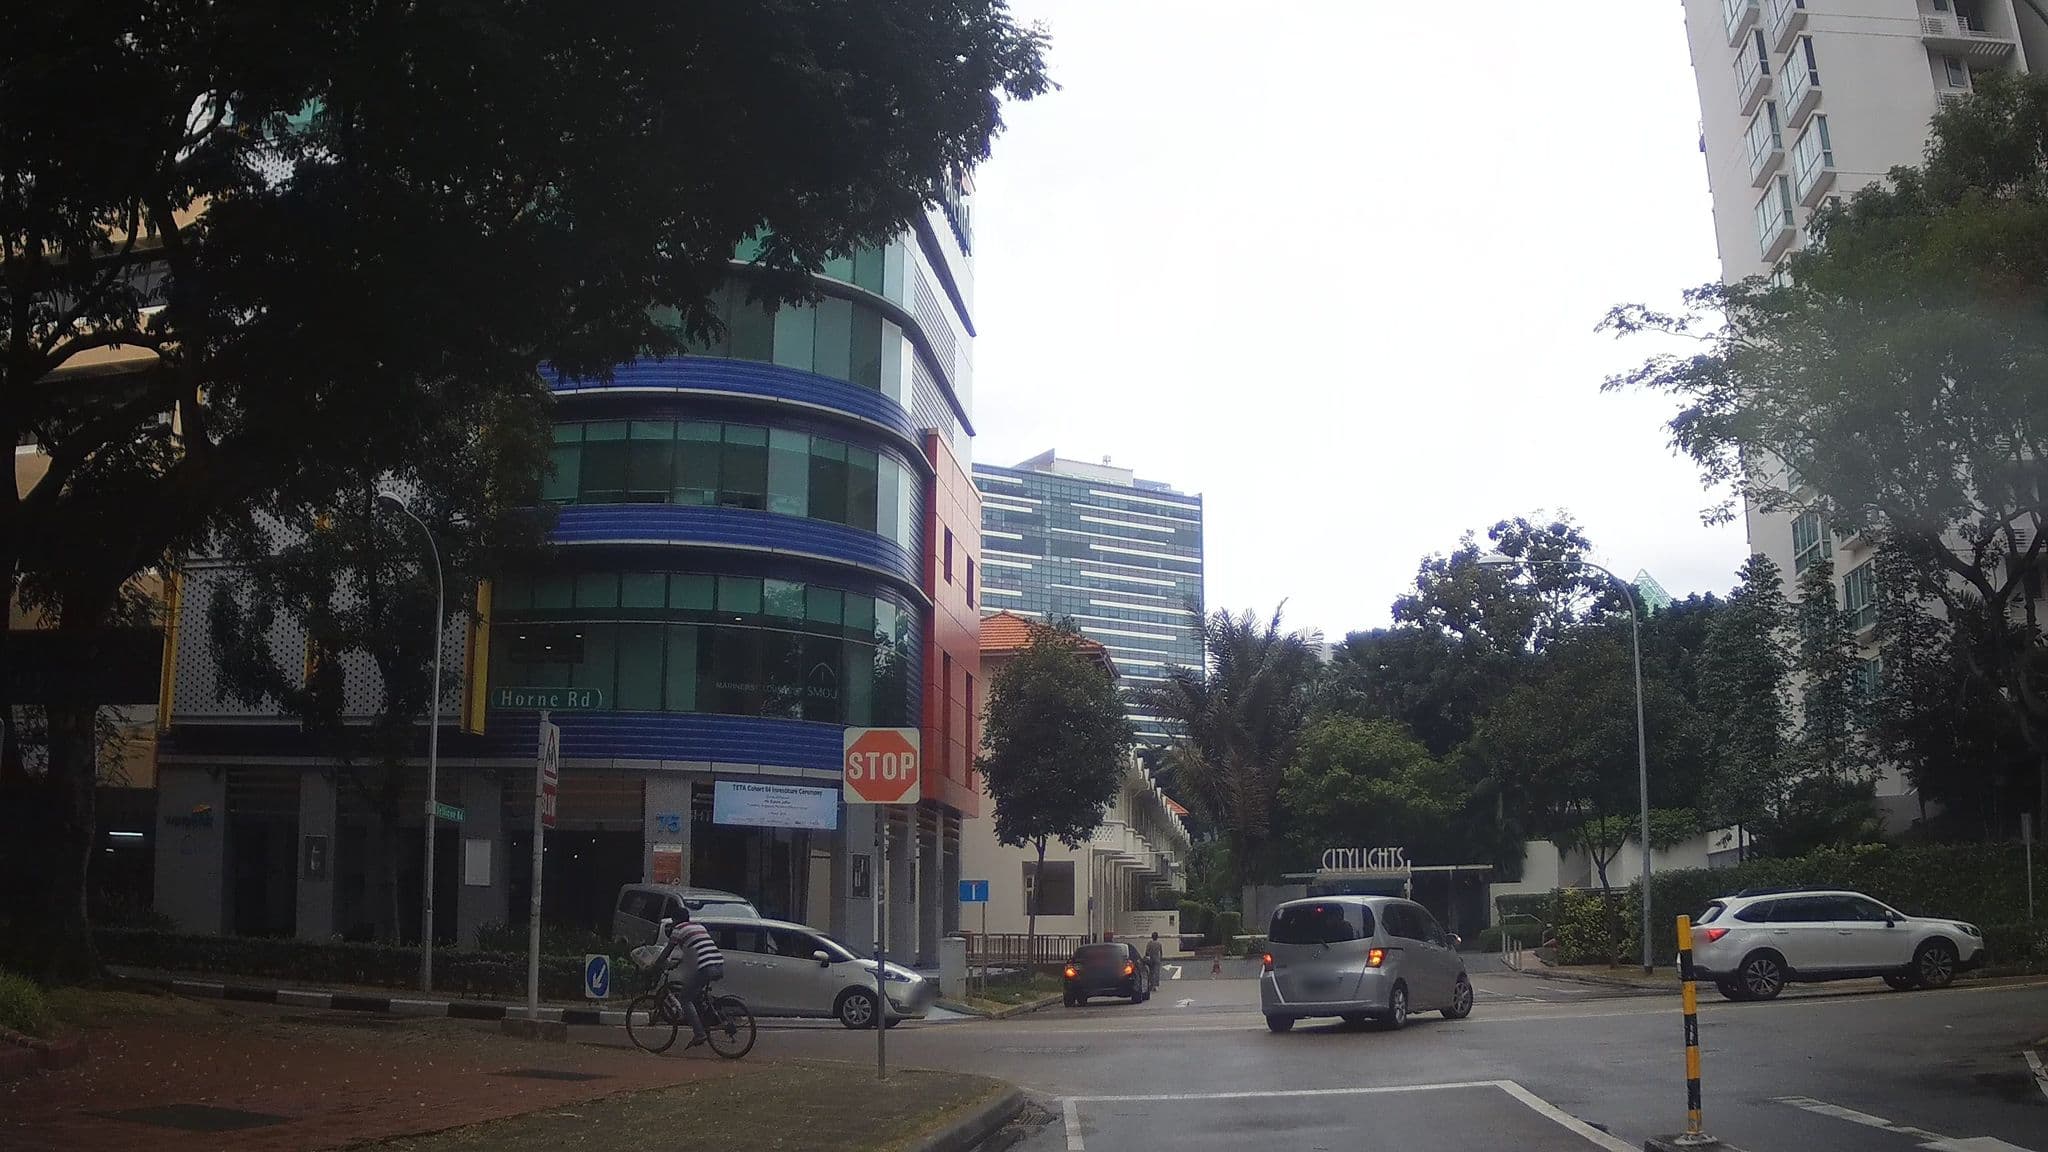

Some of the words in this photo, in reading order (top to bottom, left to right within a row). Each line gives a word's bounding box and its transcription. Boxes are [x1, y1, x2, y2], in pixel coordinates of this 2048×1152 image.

[502, 690, 559, 707] Horne
[568, 690, 591, 707] Rd
[848, 751, 915, 780] STOP
[1322, 847, 1404, 872] CITYLIGHTS
